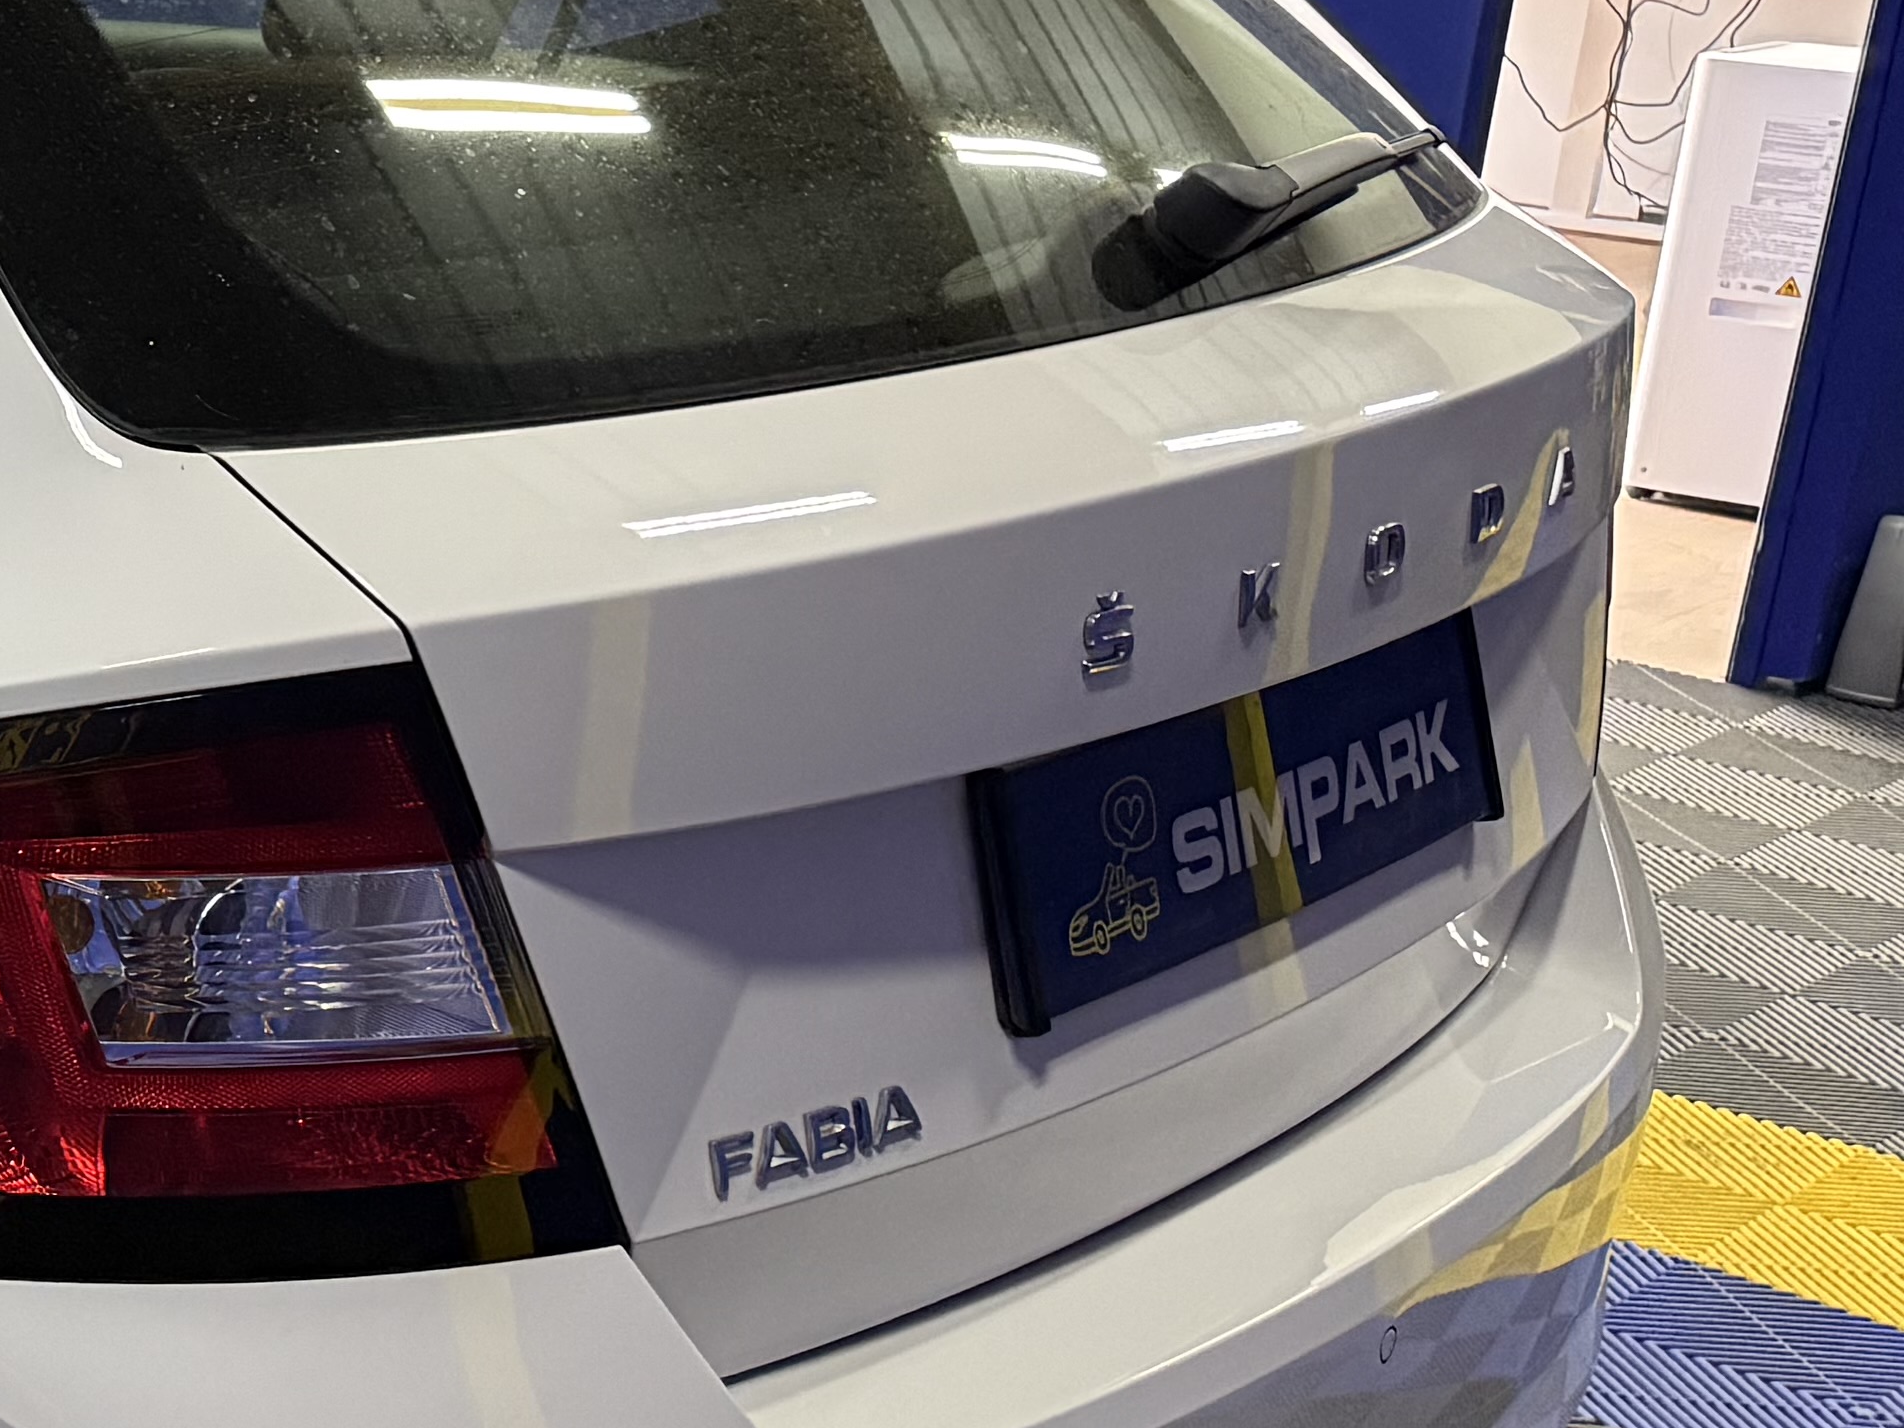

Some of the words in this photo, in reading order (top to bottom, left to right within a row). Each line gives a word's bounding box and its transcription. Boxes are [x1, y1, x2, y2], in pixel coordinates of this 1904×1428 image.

[1081, 445, 1576, 674] ŠKODA
[1171, 698, 1460, 894] SIMPARK
[708, 1085, 923, 1202] FABIA
